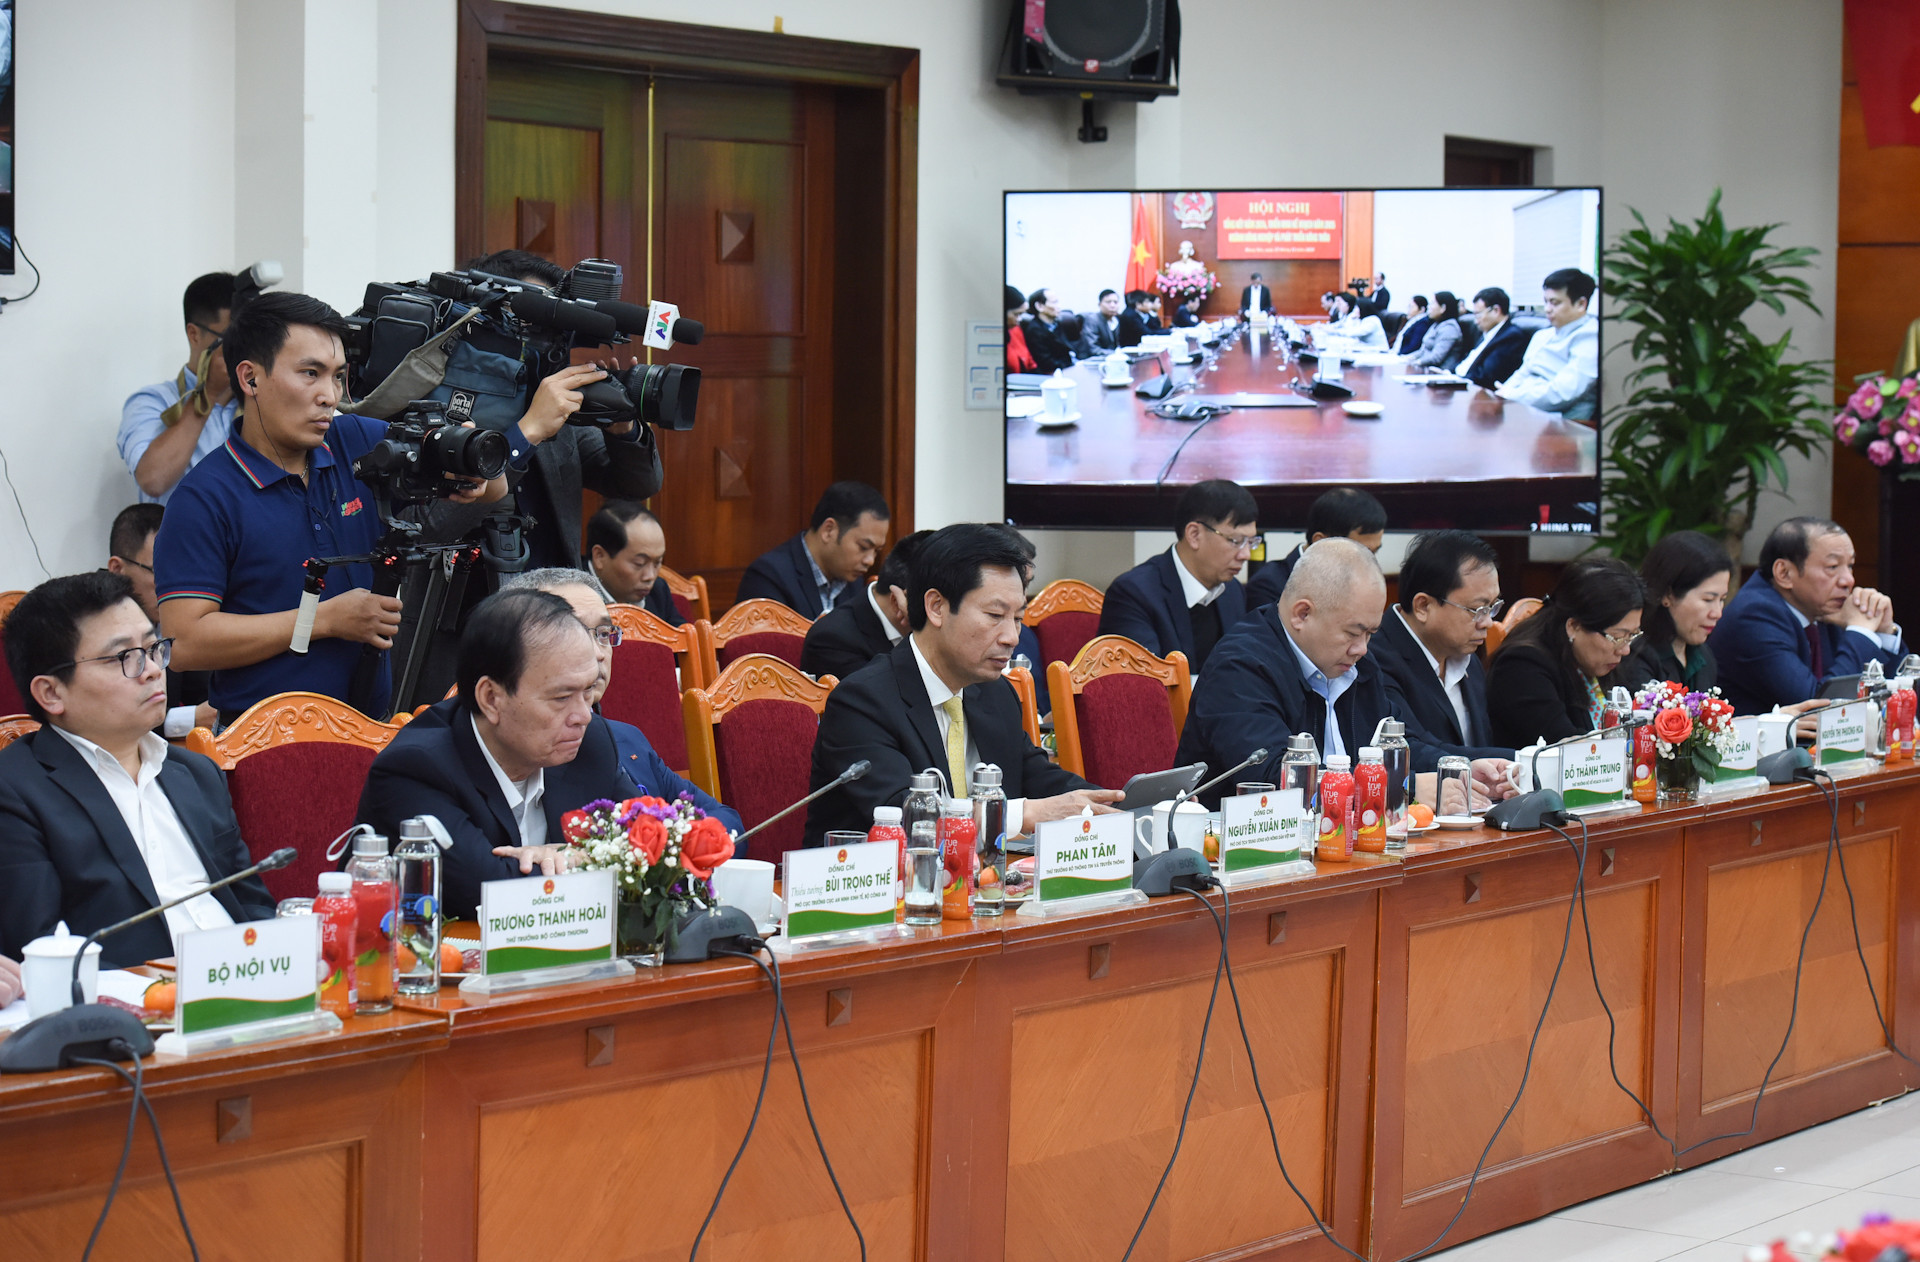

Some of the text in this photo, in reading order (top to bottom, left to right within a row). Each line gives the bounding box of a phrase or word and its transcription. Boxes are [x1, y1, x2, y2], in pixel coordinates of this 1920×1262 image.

[1249, 199, 1310, 216] HỘI NGHỊ
[656, 311, 670, 340] VTV
[1564, 762, 1621, 779] ĐỖ THÀNH TRUNG
[1324, 797, 1338, 805] TEA
[1228, 816, 1298, 838] NGUYỄN XUÂN ĐỊNH
[1074, 832, 1098, 843] ĐỒNG CHÍ
[1056, 843, 1116, 863] PHAN TÂM
[828, 862, 855, 873] ĐỒNG CHÍ
[826, 875, 839, 892] BÙI
[842, 874, 872, 892] TRỌNG
[875, 867, 892, 886] THẾ
[532, 894, 565, 906] ĐỒNG CHÍ
[489, 902, 606, 933] TRƯƠNG THANH HOÀI
[322, 922, 338, 933] rue
[322, 932, 337, 942] EA
[208, 956, 290, 986] BỘ NỘI VỤ
